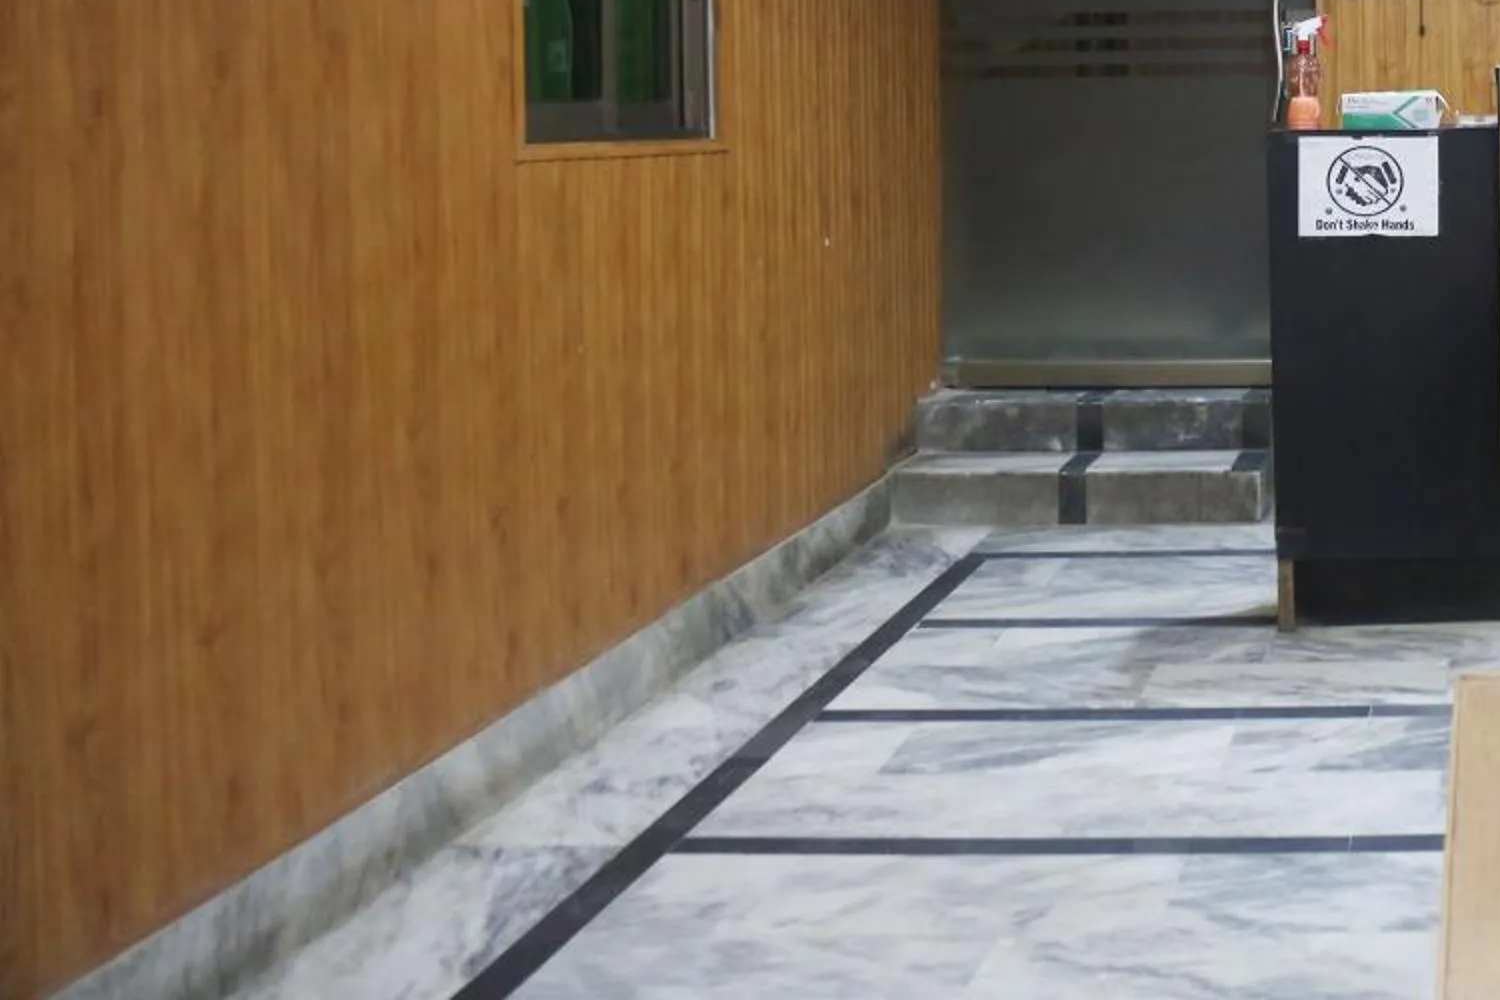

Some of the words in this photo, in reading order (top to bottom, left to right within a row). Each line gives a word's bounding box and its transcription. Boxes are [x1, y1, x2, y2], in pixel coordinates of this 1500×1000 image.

[1315, 219, 1343, 231] Don't
[1346, 219, 1379, 231] Shake
[1381, 218, 1415, 230] Hands
